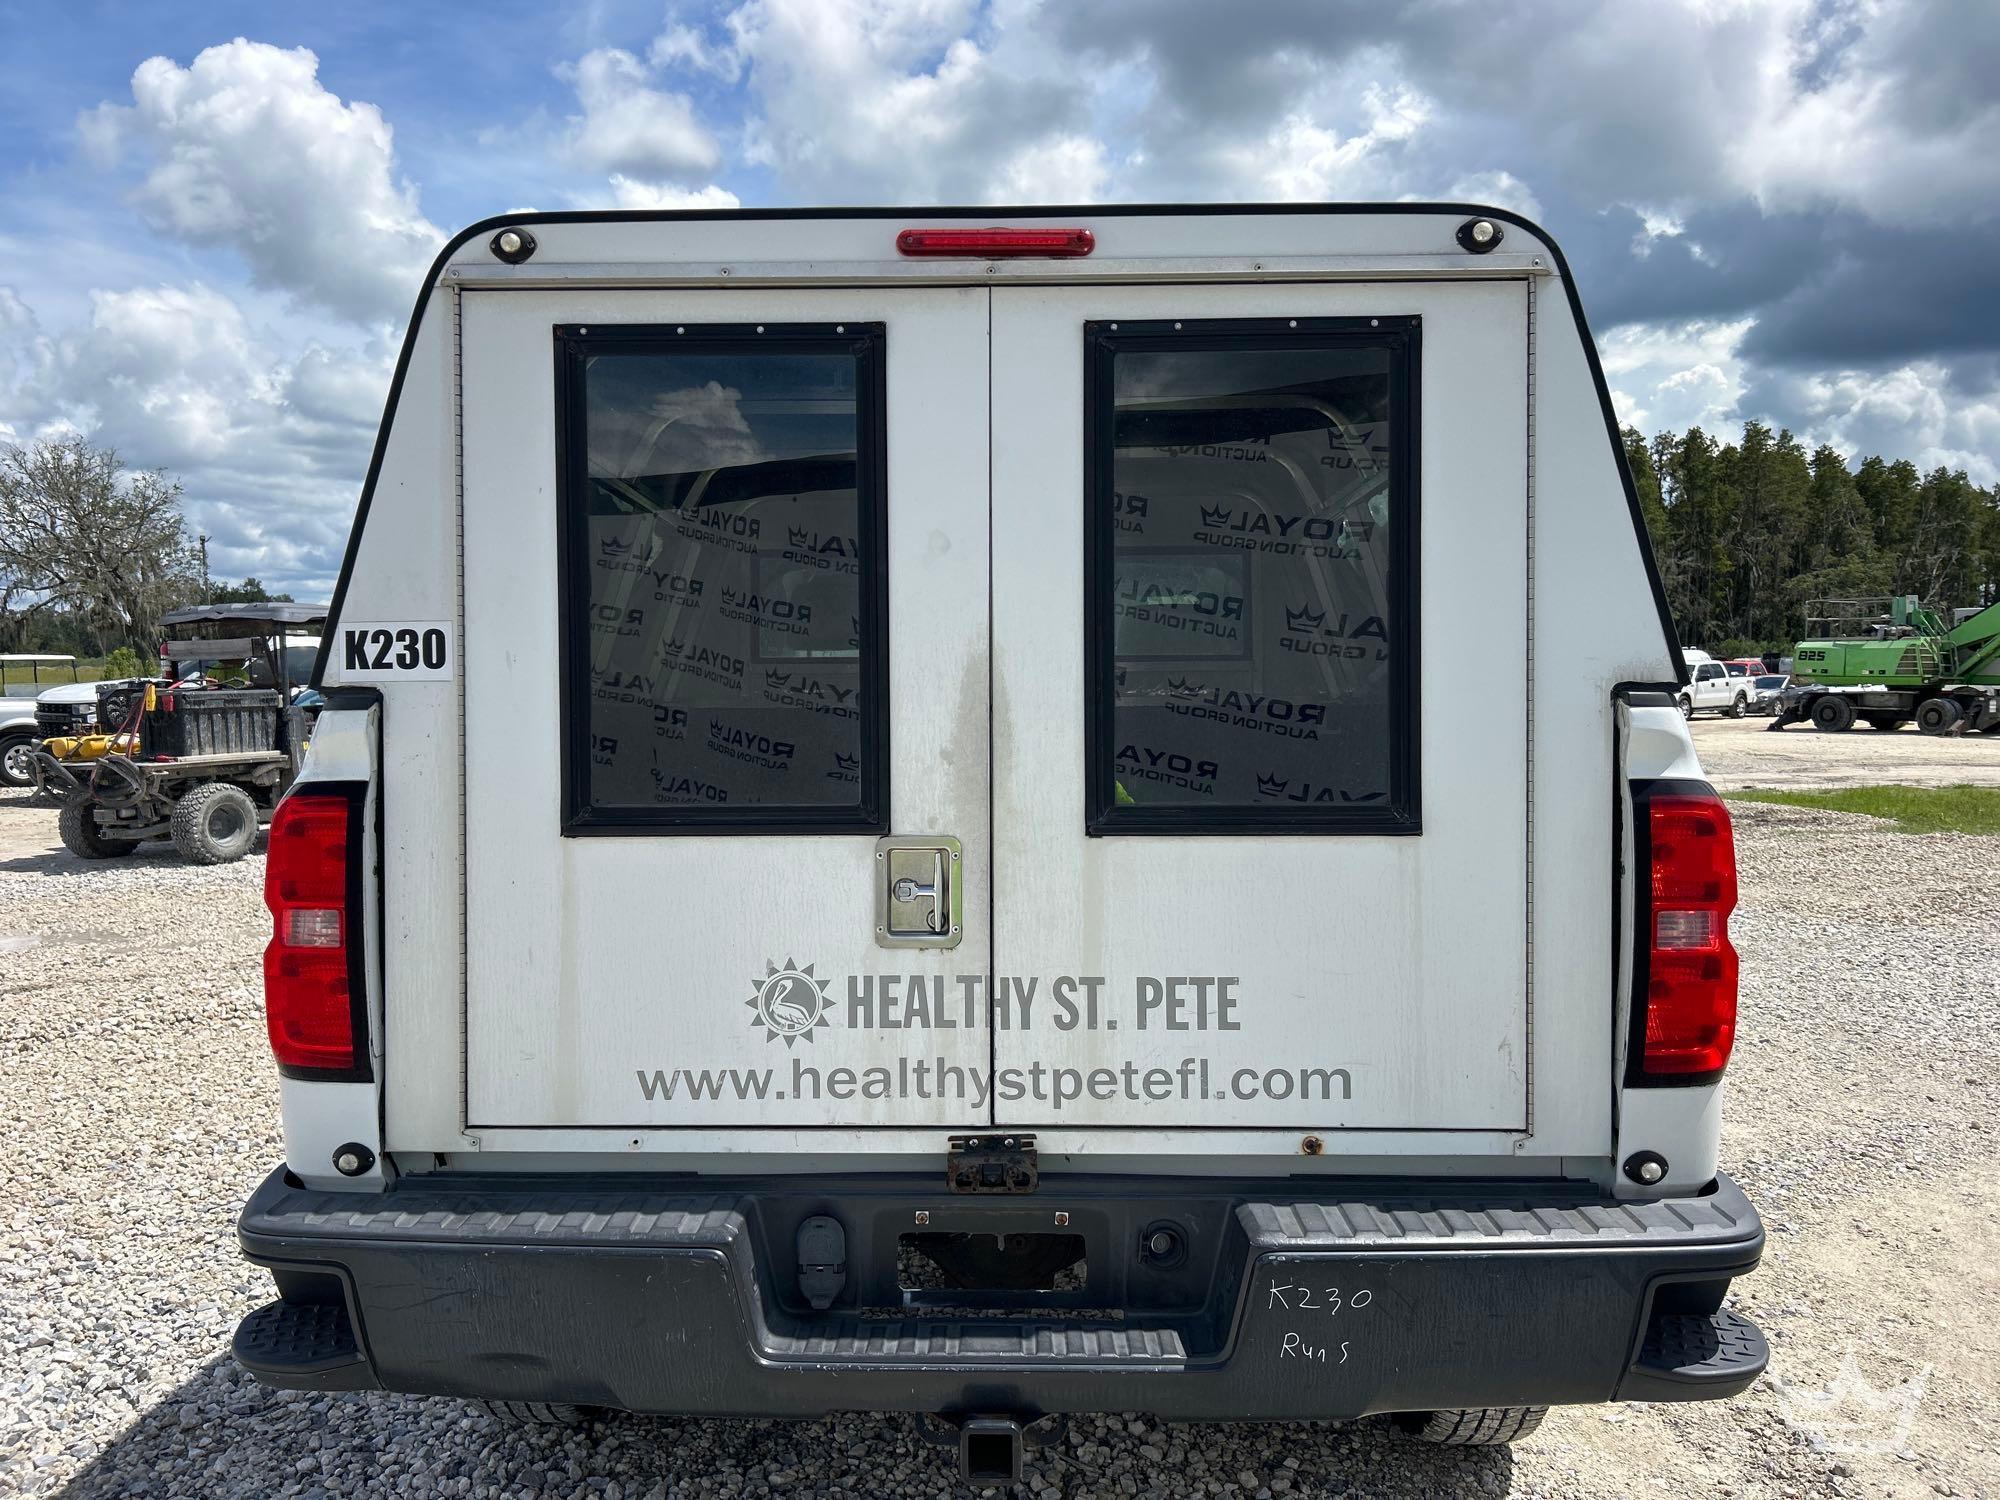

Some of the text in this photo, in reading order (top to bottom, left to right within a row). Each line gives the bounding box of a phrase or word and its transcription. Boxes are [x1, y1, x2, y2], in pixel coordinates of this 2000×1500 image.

[345, 628, 446, 670] K230
[1798, 650, 1826, 662] 825
[848, 975, 1241, 1031] HEALTHY ST. PETE
[636, 1057, 1352, 1109] www.healthystpetefl.com
[1268, 1279, 1372, 1315] K230
[1280, 1332, 1350, 1364] Runs
